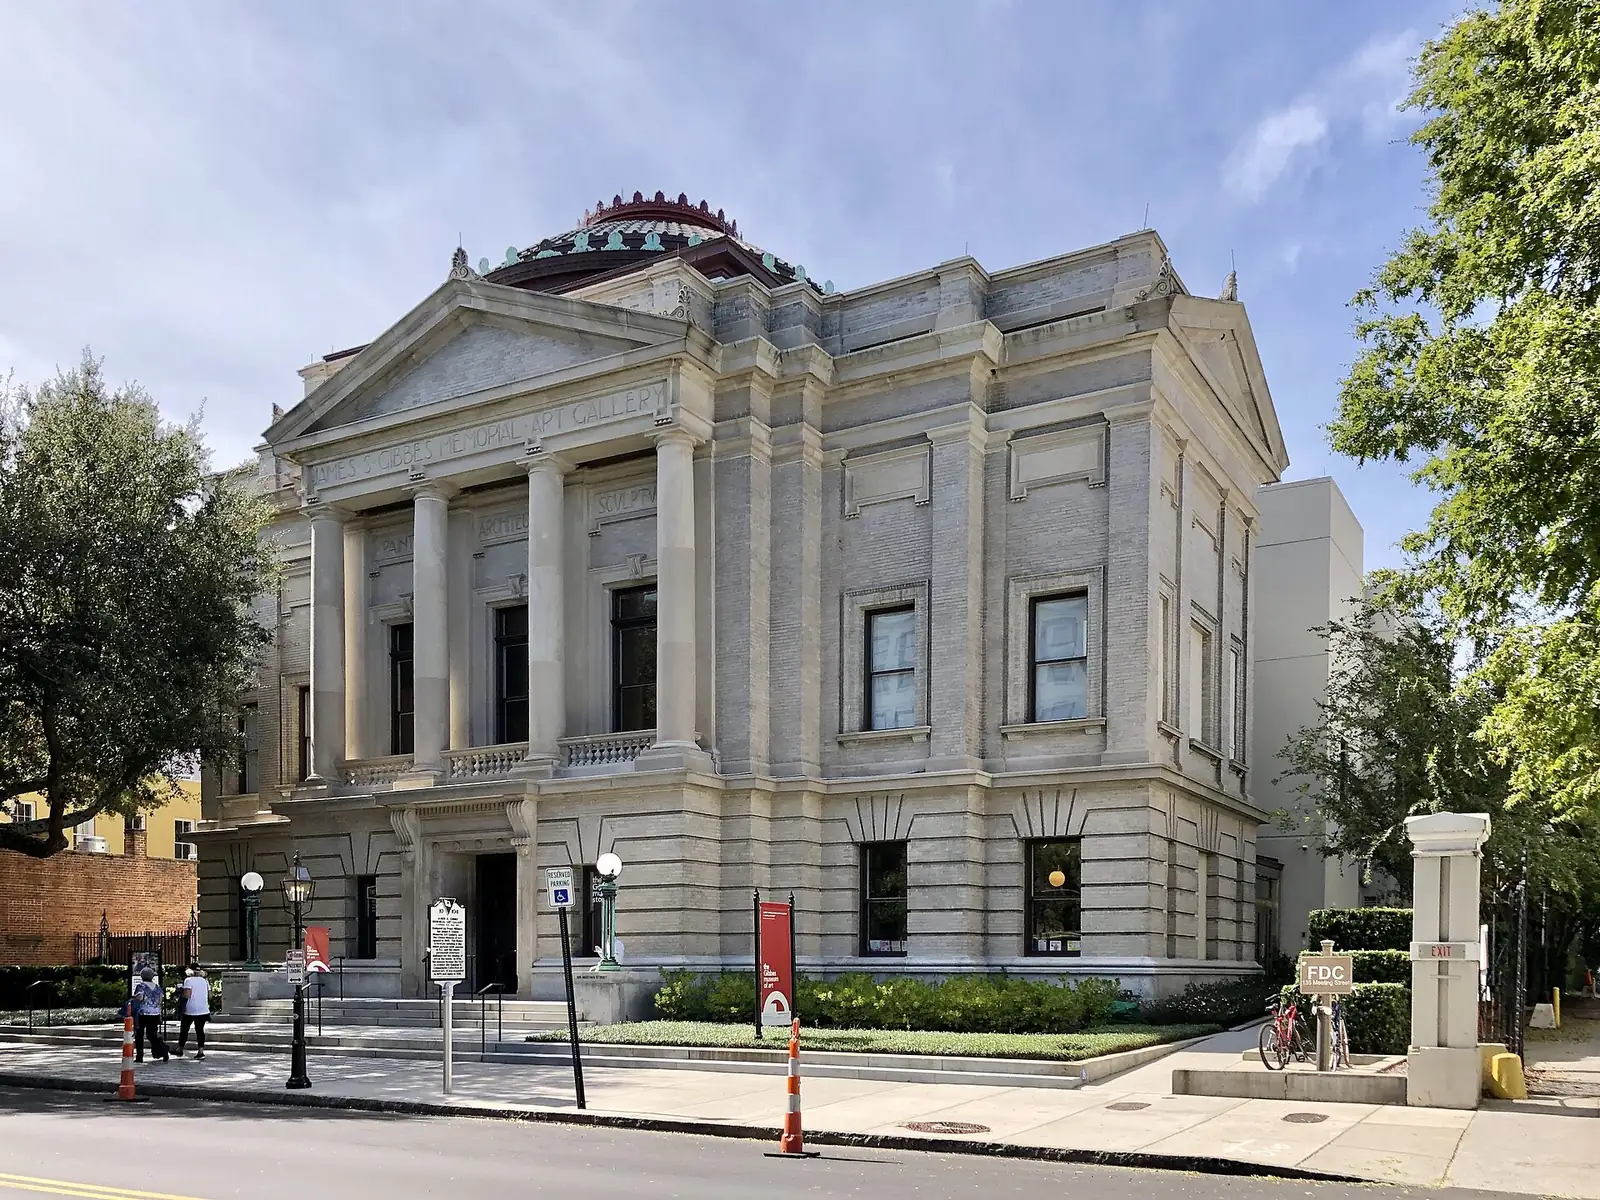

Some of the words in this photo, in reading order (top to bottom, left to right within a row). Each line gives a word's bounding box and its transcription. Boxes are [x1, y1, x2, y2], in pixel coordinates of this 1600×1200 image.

[312, 459, 356, 485] JAMES
[379, 441, 433, 470] GIBBES
[440, 421, 522, 456] MEMORIAL
[532, 408, 565, 433] ART
[573, 383, 665, 424] GALLERY
[479, 512, 529, 537] ARCHITEC
[548, 871, 571, 879] RESERVED
[1431, 946, 1452, 957] EXIT
[1307, 965, 1345, 980] FDC
